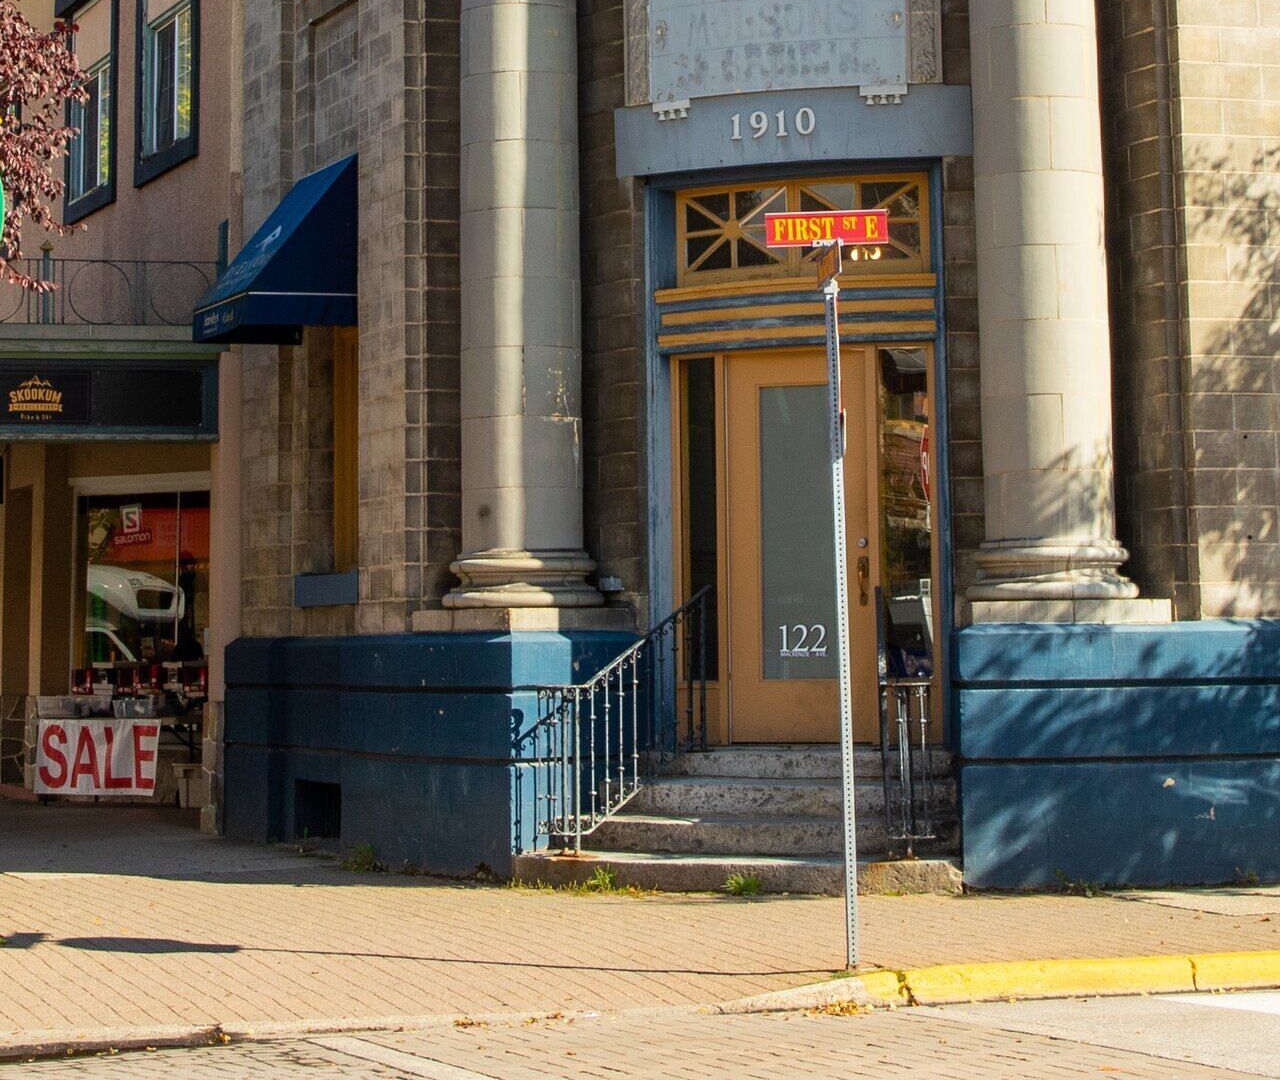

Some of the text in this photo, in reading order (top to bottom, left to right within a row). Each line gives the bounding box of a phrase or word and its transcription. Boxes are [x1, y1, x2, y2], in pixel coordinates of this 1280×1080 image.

[730, 107, 816, 141] 1910
[773, 215, 879, 241] FIRST ST E
[9, 388, 62, 403] SKOOKUM
[114, 532, 151, 545] salomon
[778, 624, 828, 652] 122
[39, 724, 158, 790] SALE
